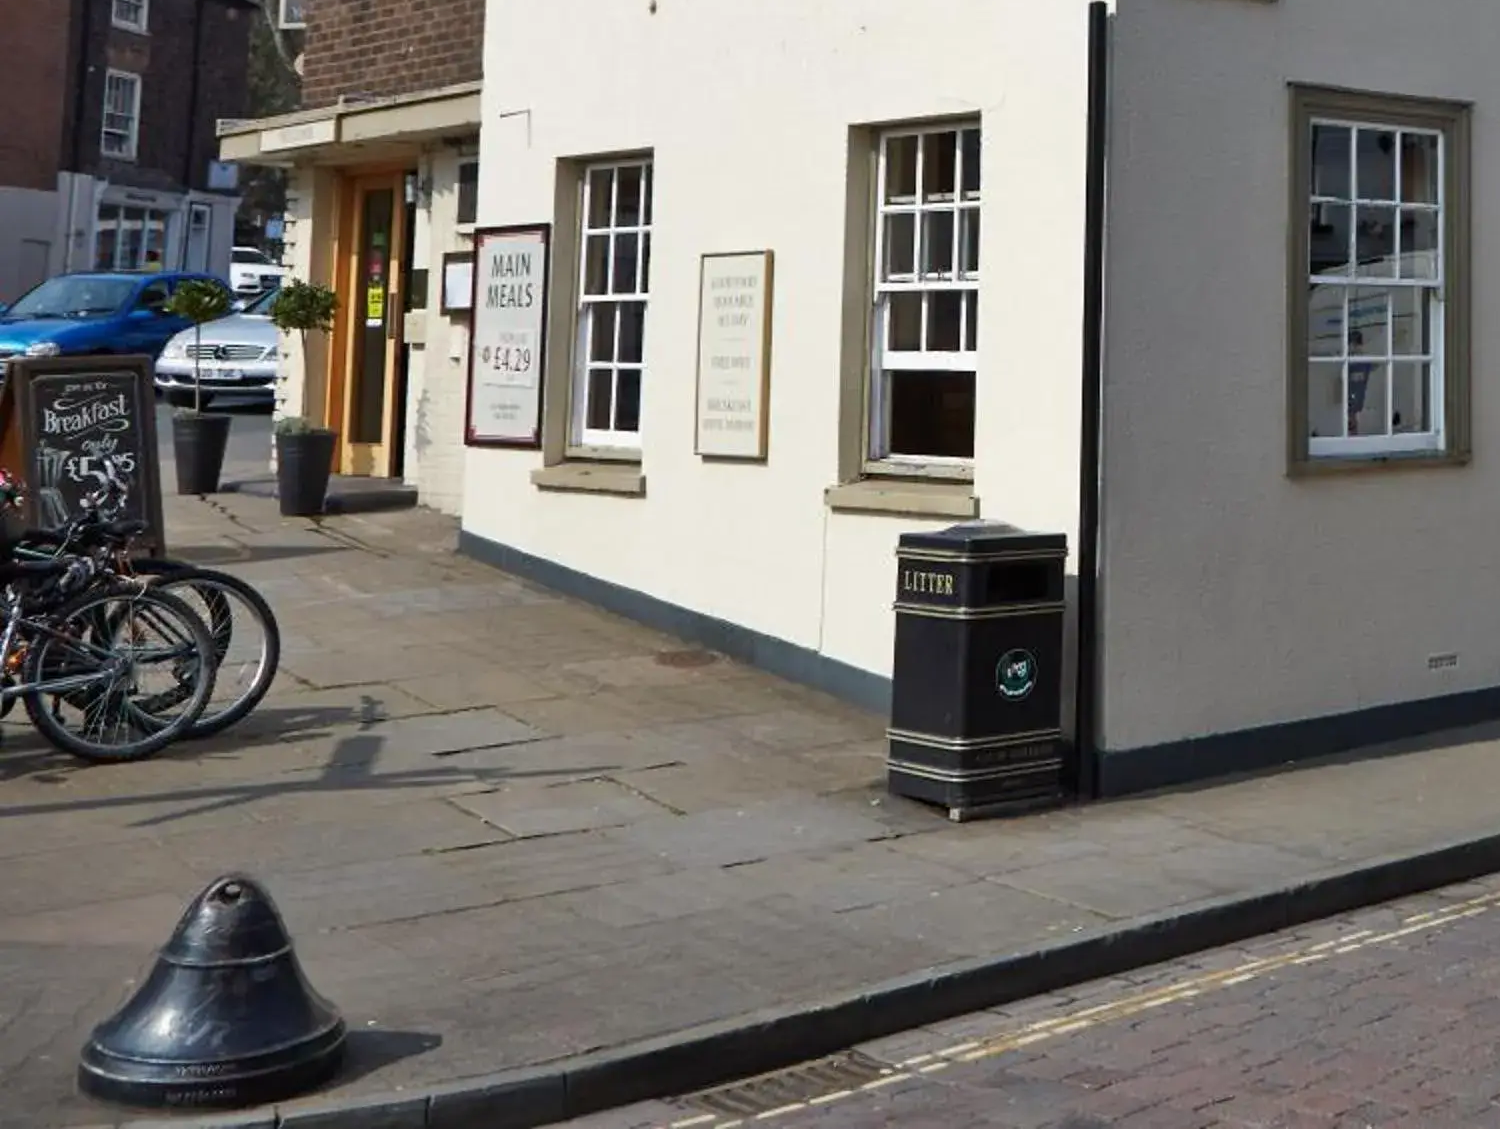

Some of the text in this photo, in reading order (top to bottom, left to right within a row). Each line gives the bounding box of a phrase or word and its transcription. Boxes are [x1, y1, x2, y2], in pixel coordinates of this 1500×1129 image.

[491, 253, 531, 278] MAIN
[486, 282, 533, 308] MEALS
[493, 346, 531, 373] £4.29
[43, 393, 130, 433] Breakfast
[905, 571, 953, 594] LITTER
